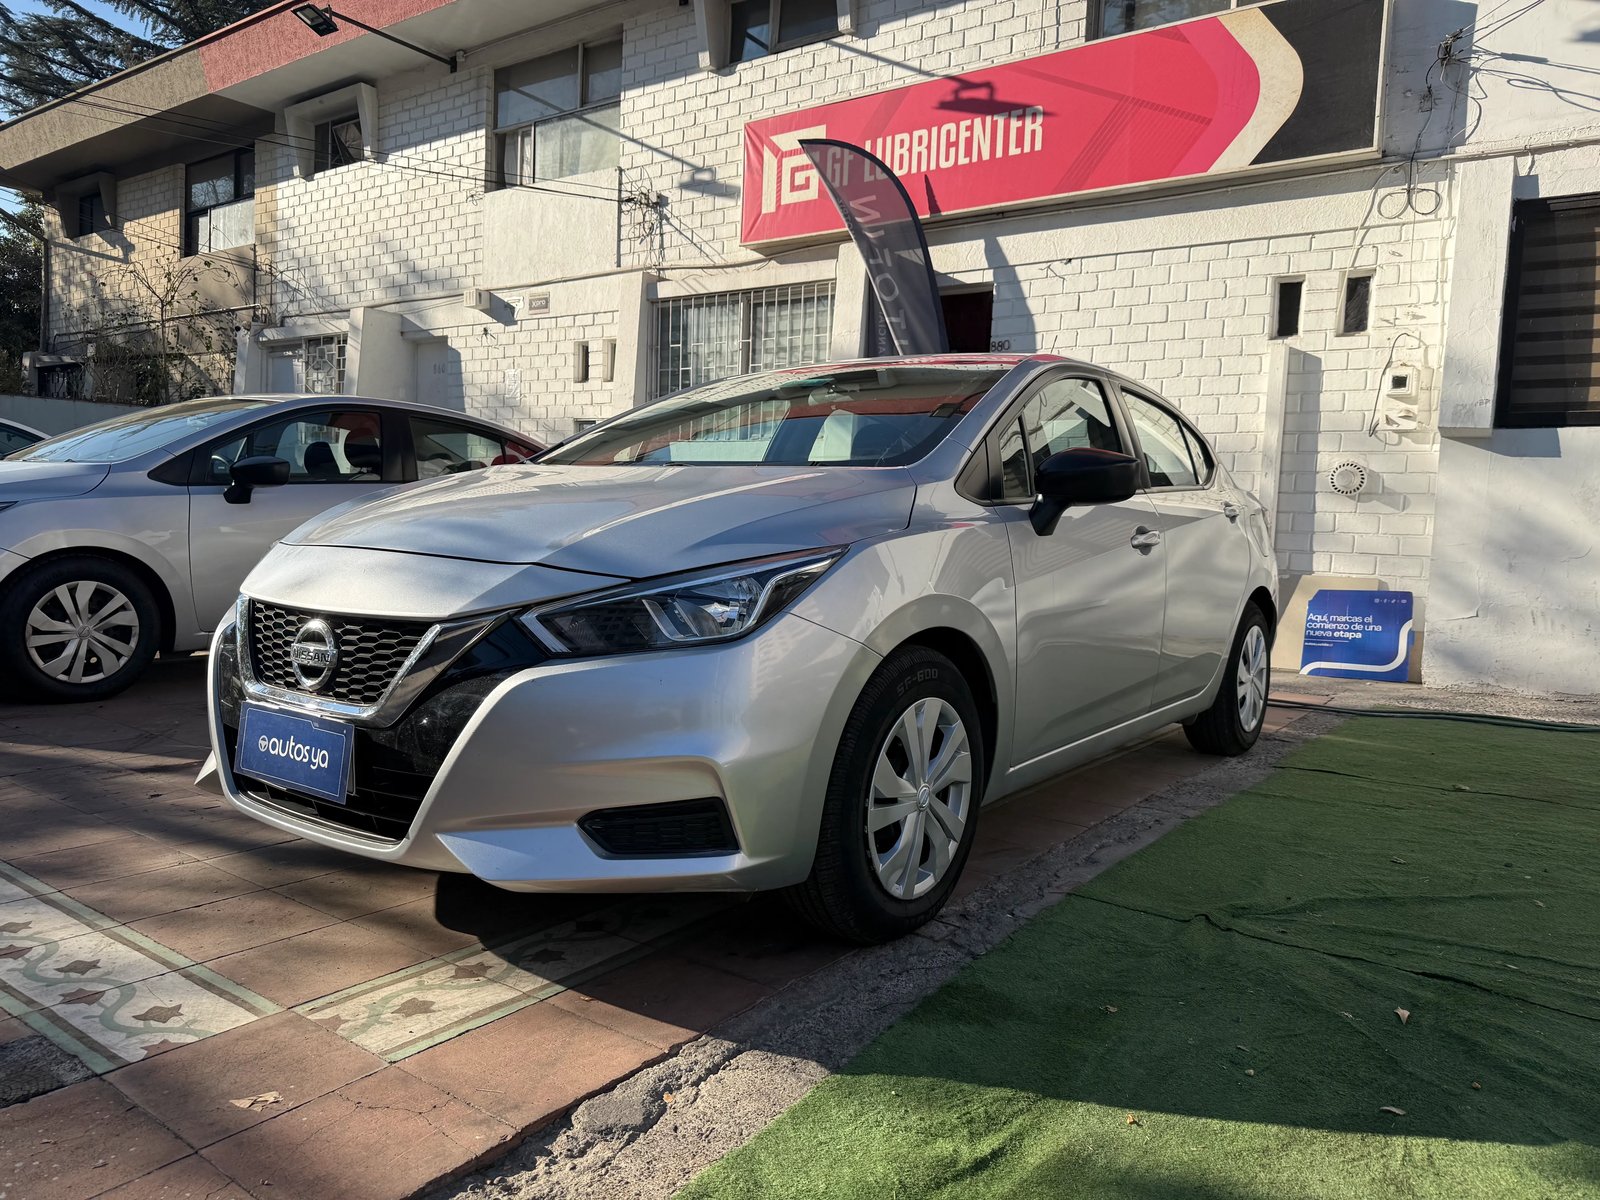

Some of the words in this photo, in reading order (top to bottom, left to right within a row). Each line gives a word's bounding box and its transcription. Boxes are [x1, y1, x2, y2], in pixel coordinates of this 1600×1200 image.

[864, 106, 1044, 183] LUBRICENTER
[990, 340, 1010, 352] 880
[1364, 615, 1373, 623] el
[1306, 621, 1349, 630] comienzo
[1351, 623, 1364, 631] de
[1333, 631, 1363, 640] etapa
[292, 646, 332, 662] NISSAN
[896, 668, 939, 697] SF-600
